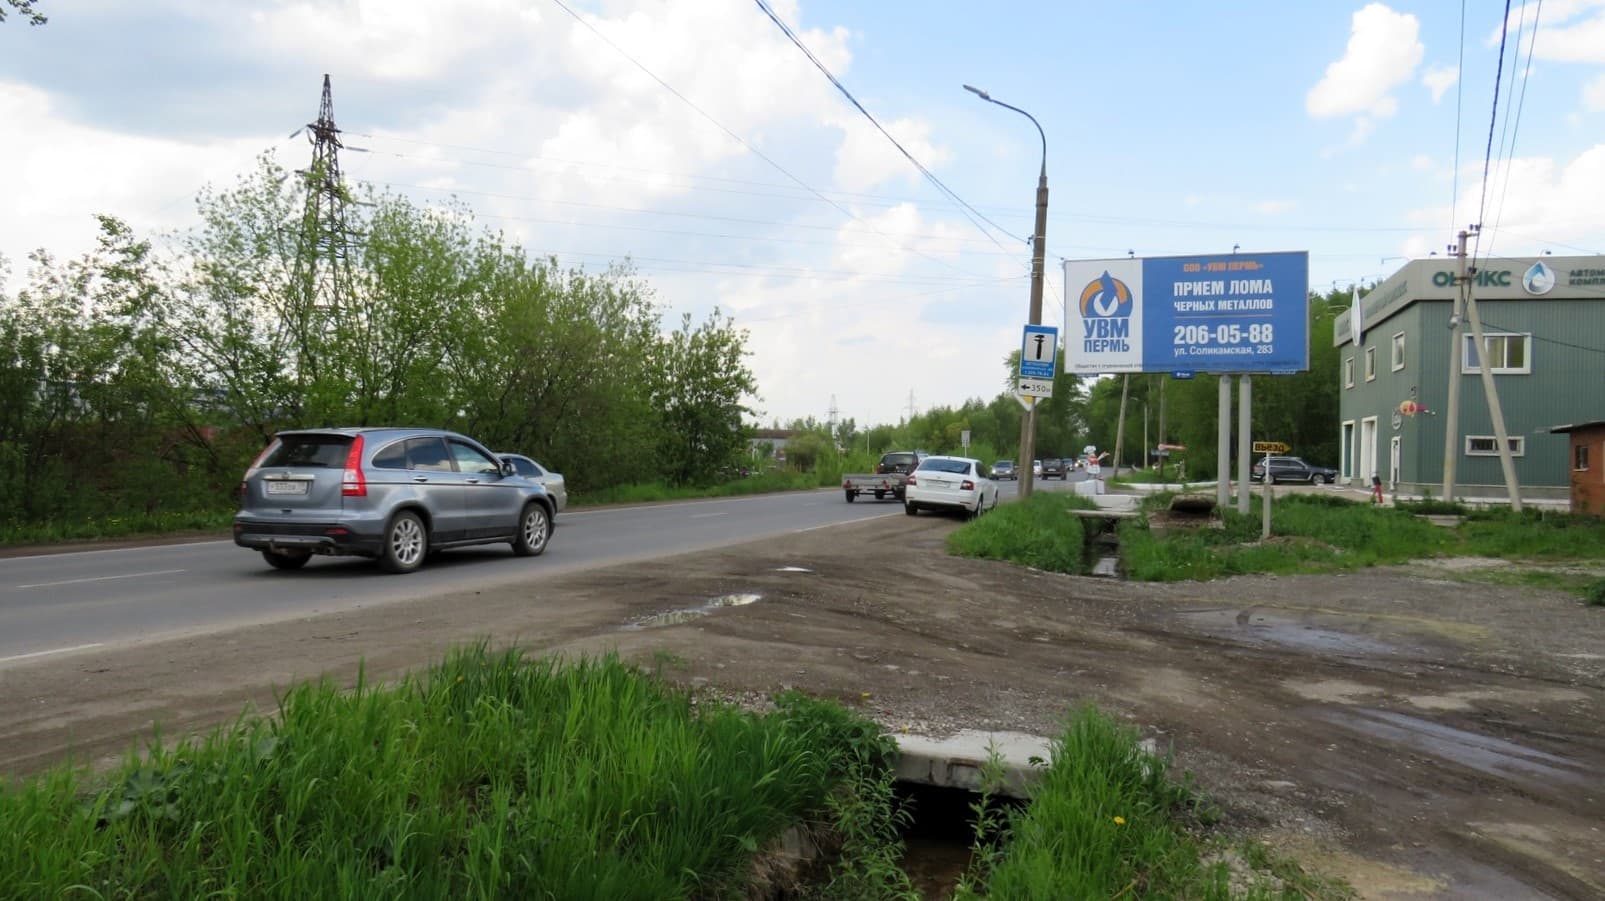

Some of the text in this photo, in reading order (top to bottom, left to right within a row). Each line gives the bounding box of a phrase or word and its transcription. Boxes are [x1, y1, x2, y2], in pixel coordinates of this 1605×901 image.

[1174, 279, 1273, 297] ПРИЕМ ЛОМА
[1174, 299, 1273, 312] ЧЕРНЫХ МЕТАЛЛОВ
[1083, 318, 1129, 339] УВМ
[1174, 323, 1273, 345] 206-05-88
[1084, 339, 1130, 353] ПЕРМЬ
[1174, 345, 1273, 357] ул. Соликамская, 283
